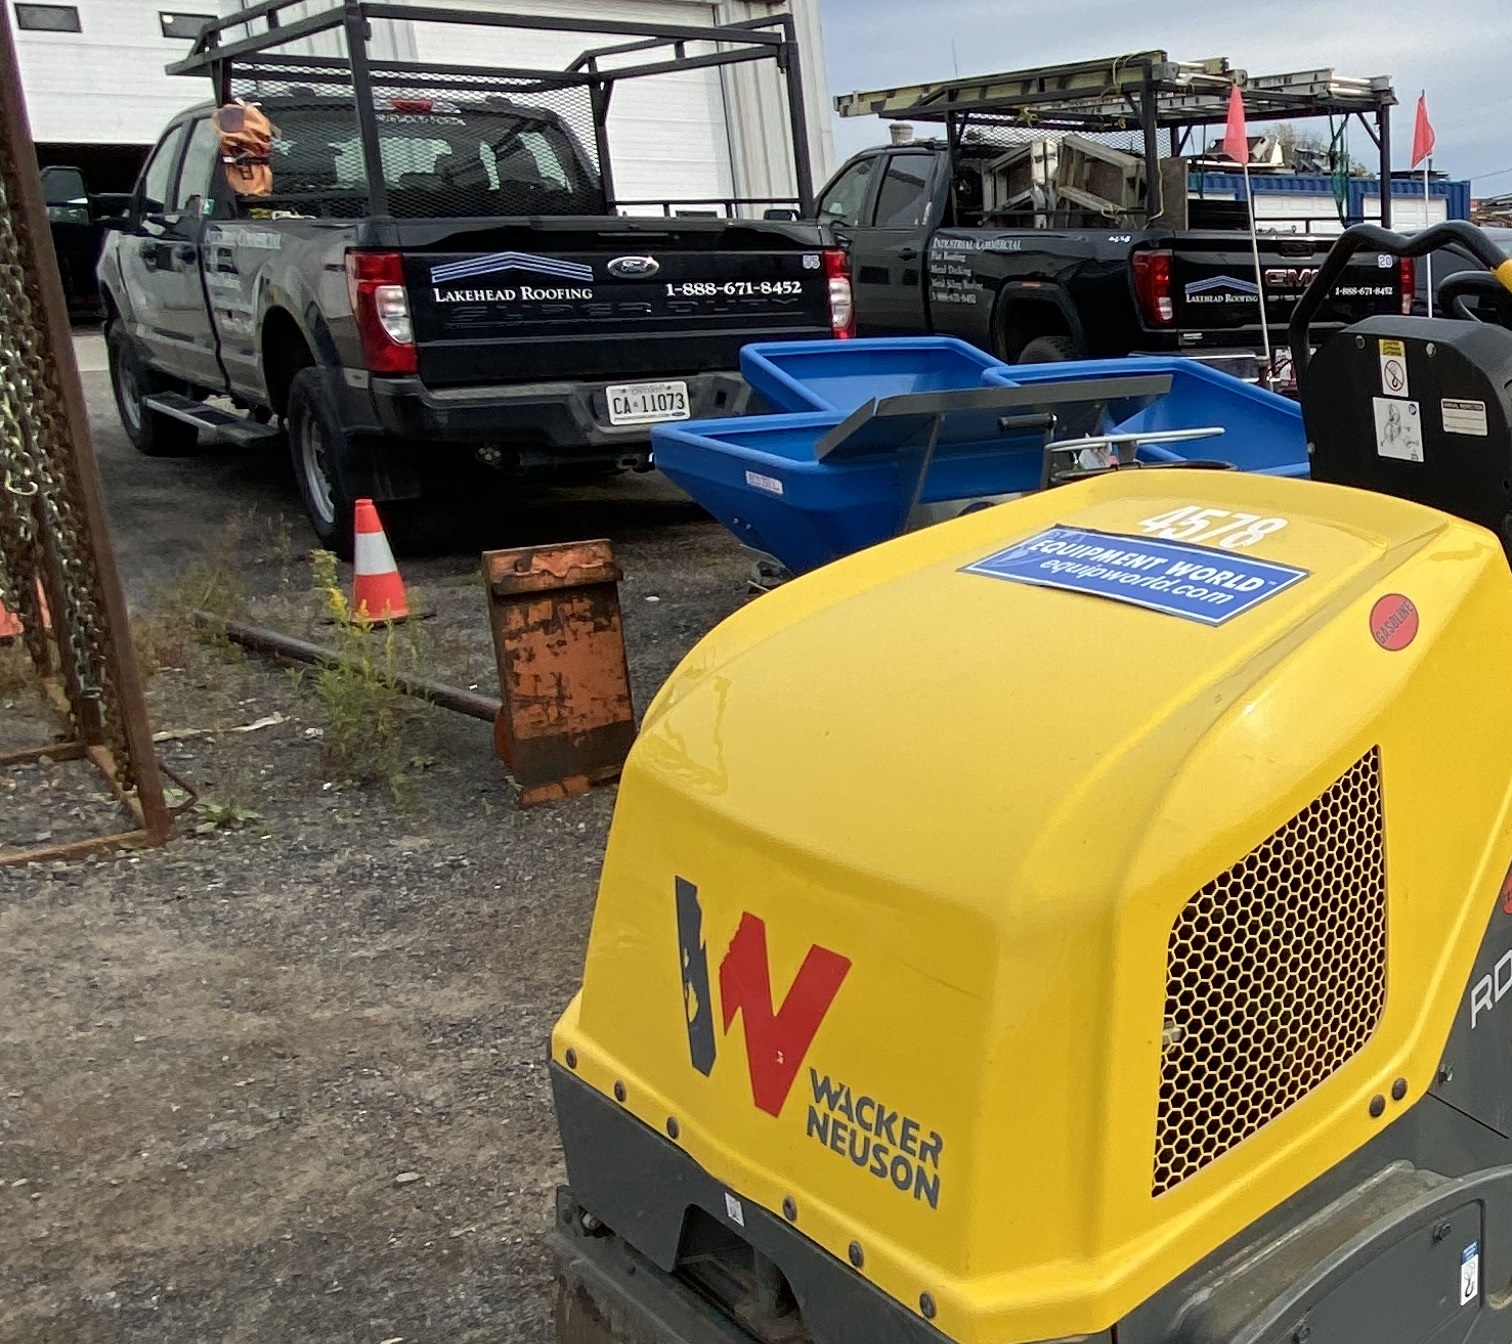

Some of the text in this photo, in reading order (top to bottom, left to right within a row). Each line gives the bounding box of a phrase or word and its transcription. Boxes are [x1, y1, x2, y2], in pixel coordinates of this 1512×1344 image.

[1378, 254, 1393, 269] 20
[433, 285, 594, 303] LAKEHEAD ROOFING
[665, 281, 802, 297] 1-888-671-8452
[1186, 292, 1224, 303] LAKEHEAD
[1225, 293, 1259, 303] ROOFING
[613, 392, 685, 415] CA 11073
[1138, 505, 1289, 549] 4578
[1027, 539, 1266, 592] EQUIPMENT WORLD
[1040, 558, 1236, 605] equipworld.com
[1375, 600, 1414, 645] GASOLINE
[808, 1066, 944, 1170] WACKER
[806, 1104, 942, 1211] NEUSON
